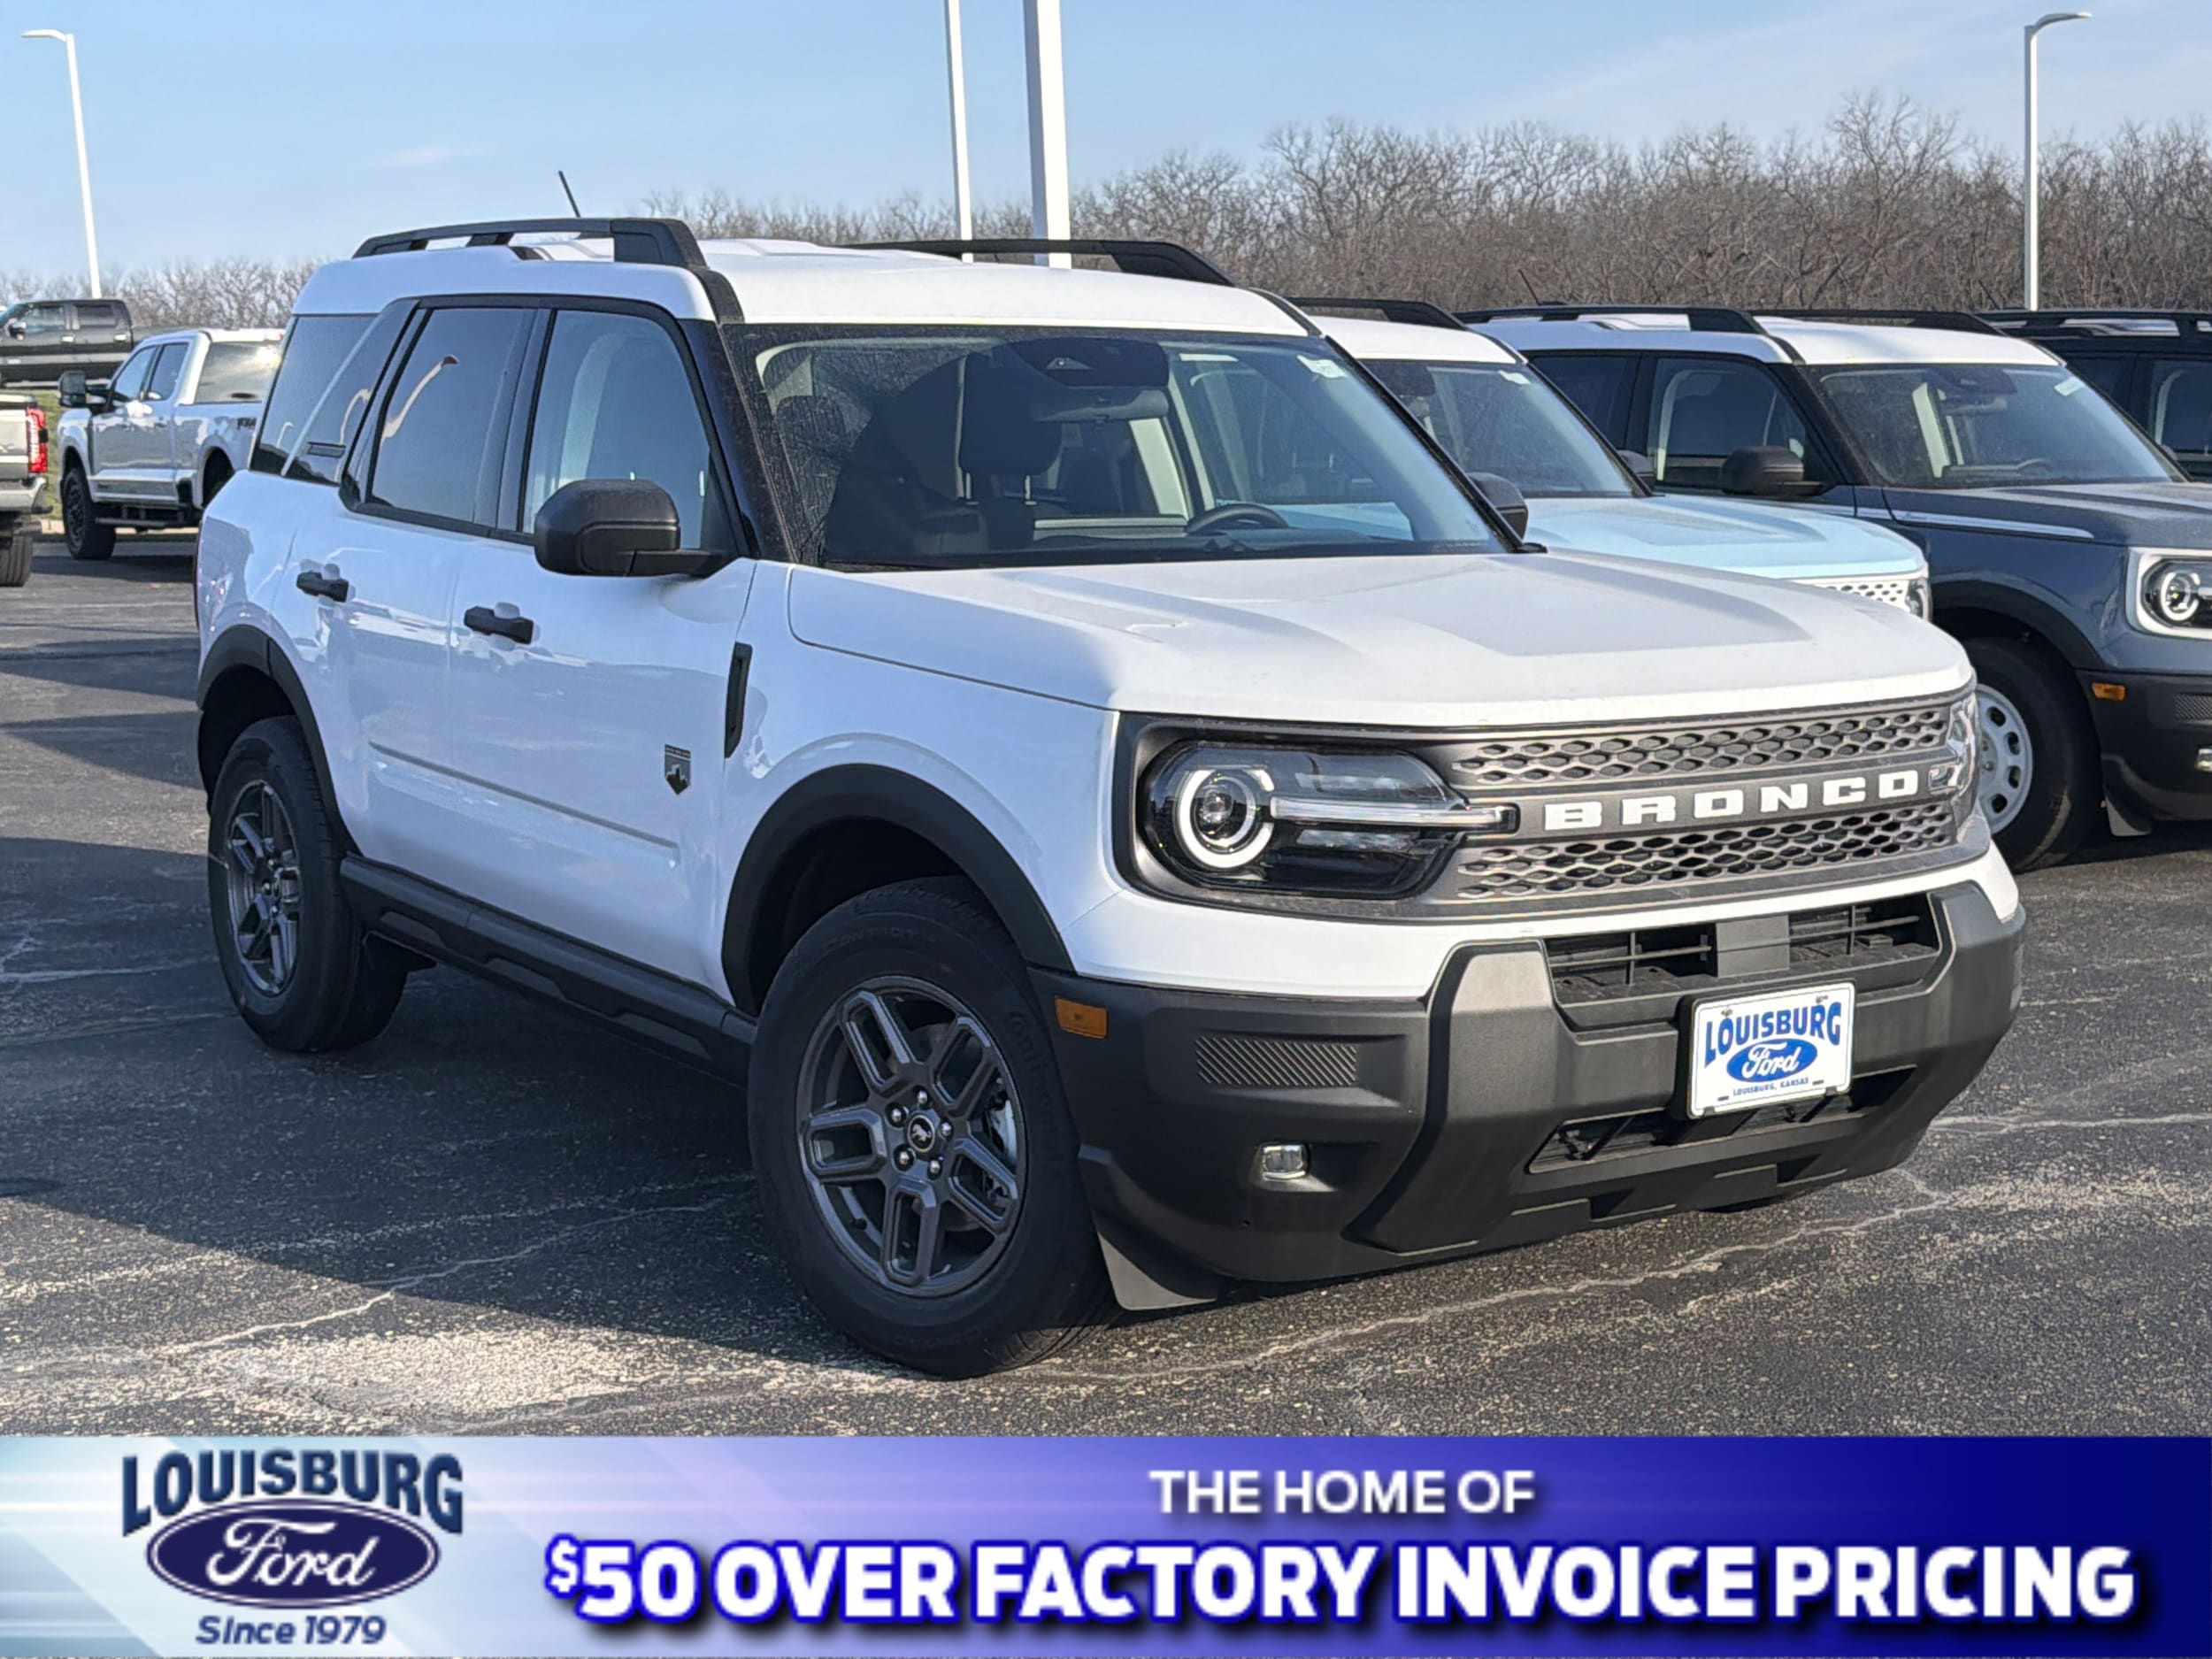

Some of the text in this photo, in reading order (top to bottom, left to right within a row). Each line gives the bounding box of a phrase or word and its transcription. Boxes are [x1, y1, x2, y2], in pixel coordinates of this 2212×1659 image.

[1543, 769, 1919, 831] BRONCO
[1704, 1001, 1842, 1069] LOUISBURG
[1740, 1041, 1802, 1079] Ford
[1780, 1077, 1809, 1088] KANSAS
